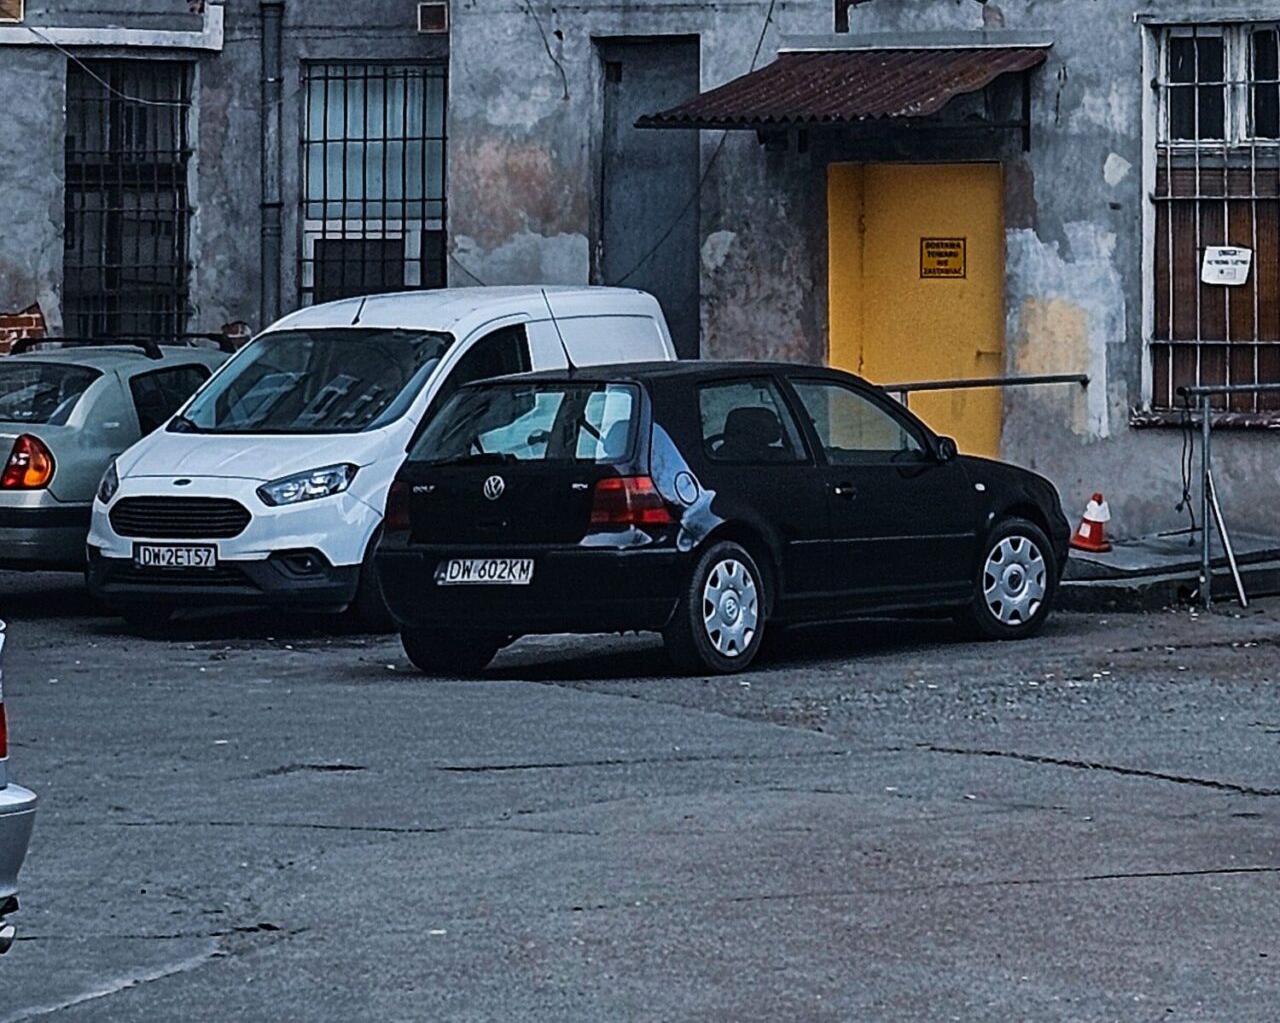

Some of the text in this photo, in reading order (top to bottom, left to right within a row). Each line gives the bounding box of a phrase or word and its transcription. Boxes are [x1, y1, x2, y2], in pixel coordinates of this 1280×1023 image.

[166, 548, 212, 566] 2ET57
[450, 560, 531, 579] DW 602KM
